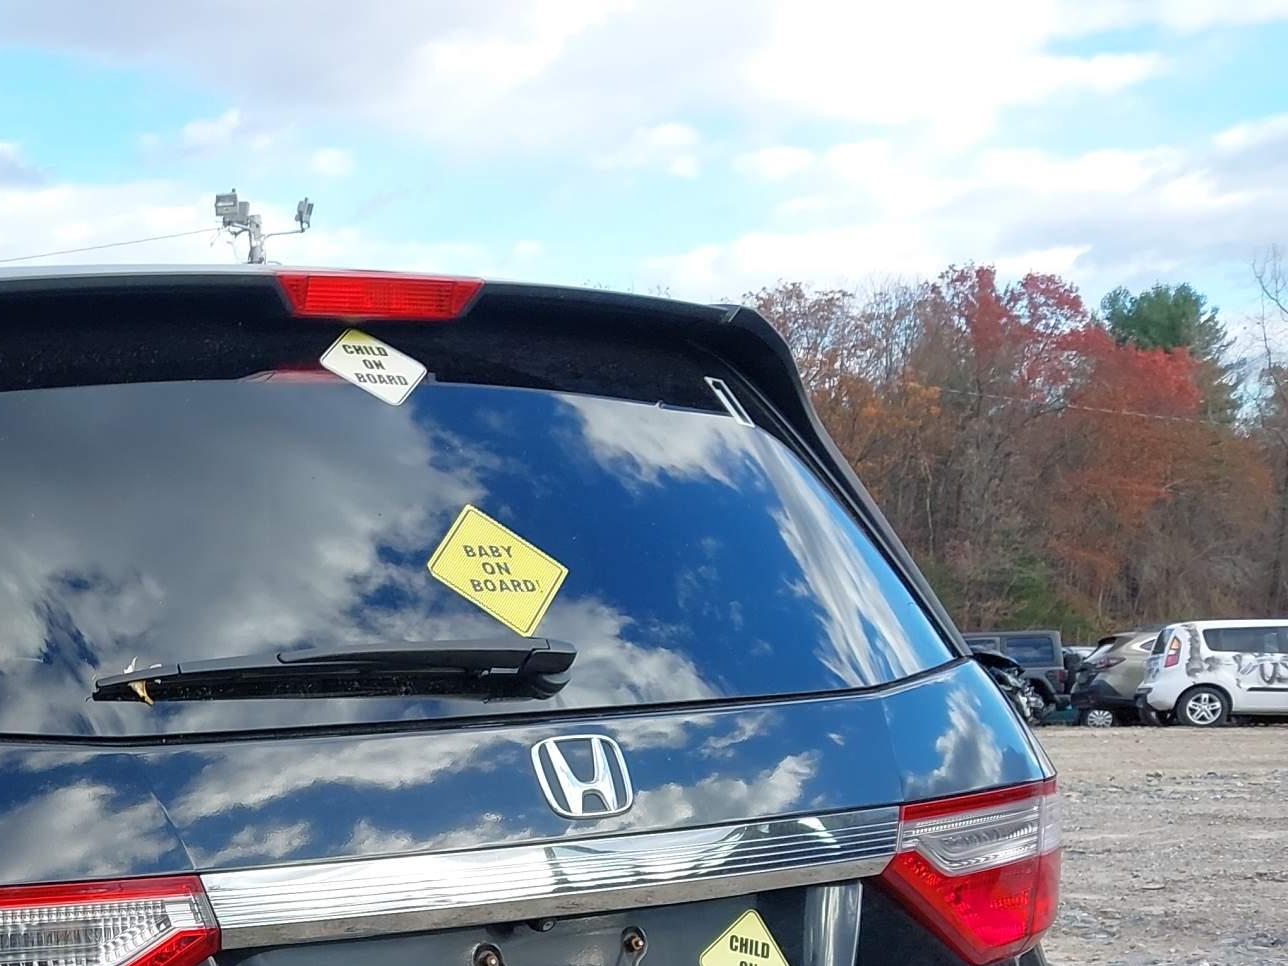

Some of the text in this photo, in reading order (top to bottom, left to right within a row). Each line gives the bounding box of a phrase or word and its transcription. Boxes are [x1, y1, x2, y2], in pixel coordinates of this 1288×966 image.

[342, 343, 389, 357] CHILD
[362, 359, 386, 370] ON
[353, 372, 409, 386] BOARD
[463, 545, 513, 558] BABY
[481, 562, 512, 575] ON
[470, 579, 544, 594] BOARD!
[729, 934, 770, 959] CHILD
